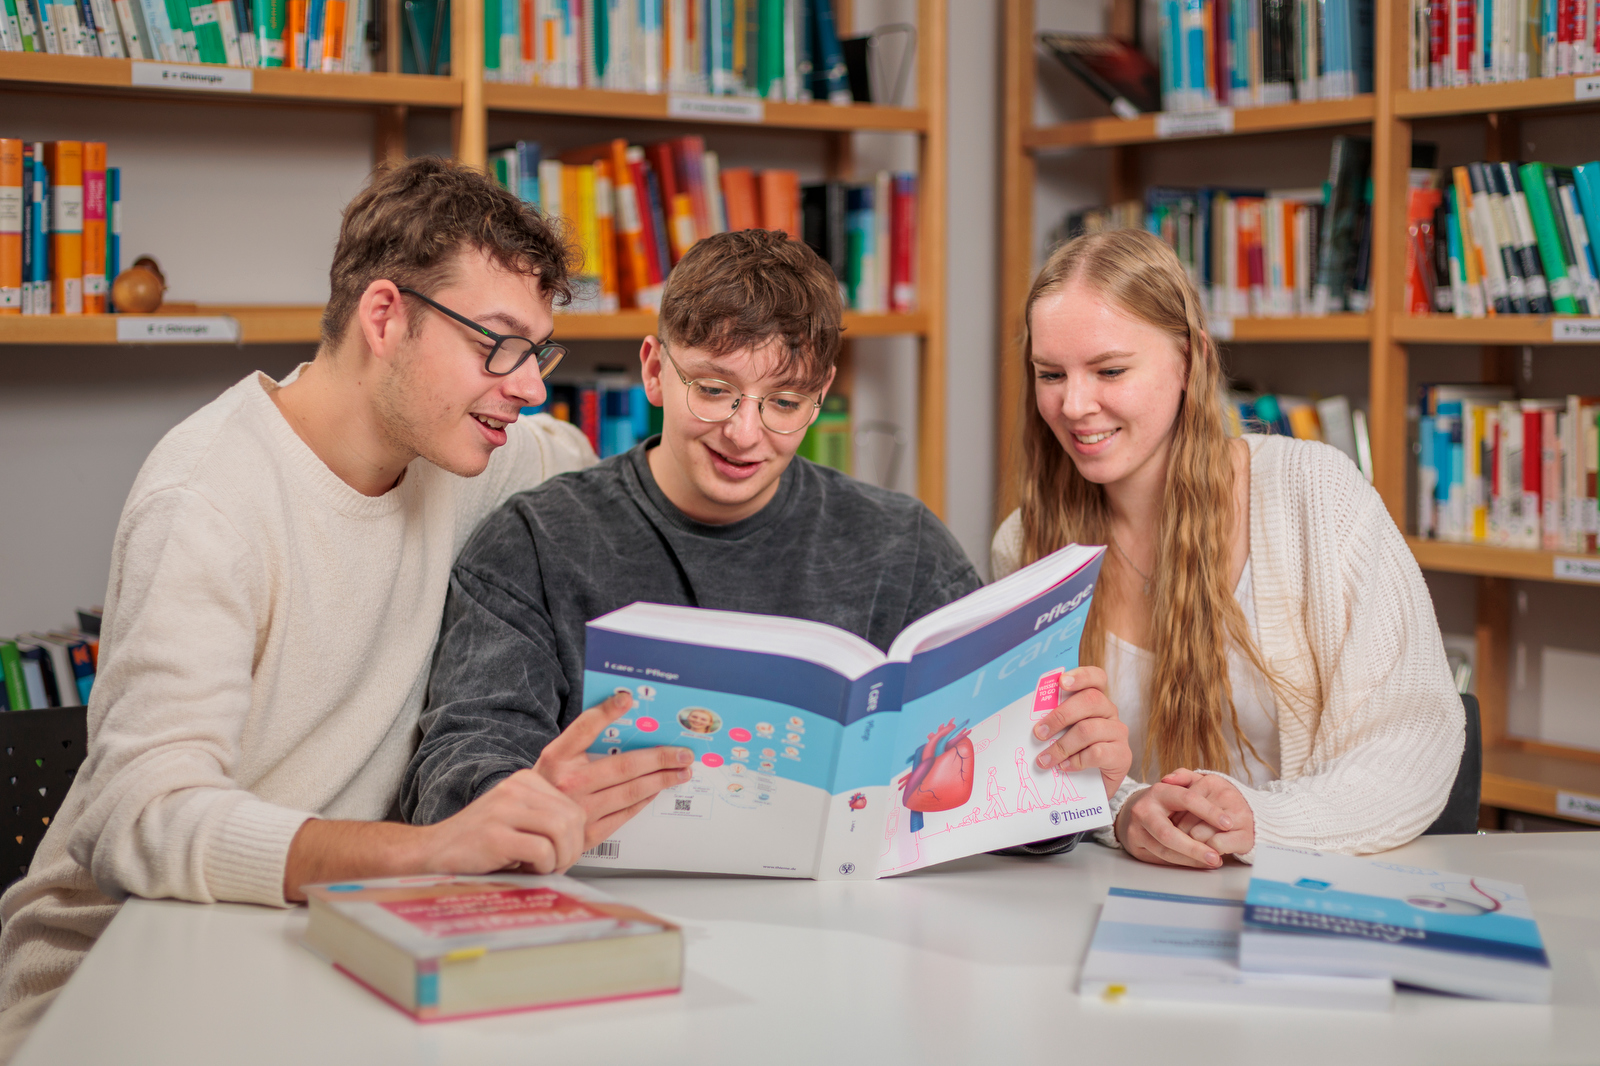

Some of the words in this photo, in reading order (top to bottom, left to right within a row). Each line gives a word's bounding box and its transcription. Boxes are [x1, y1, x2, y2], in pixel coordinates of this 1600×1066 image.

[1033, 583, 1094, 631] Pflege
[997, 615, 1083, 681] care
[610, 663, 635, 673] care
[645, 667, 680, 680] Pflege
[1038, 682, 1059, 692] WISSEN
[866, 689, 880, 713] care
[1060, 805, 1103, 822] Thieme
[1252, 914, 1403, 942] Anatomie
[1254, 906, 1427, 939] Physiologie
